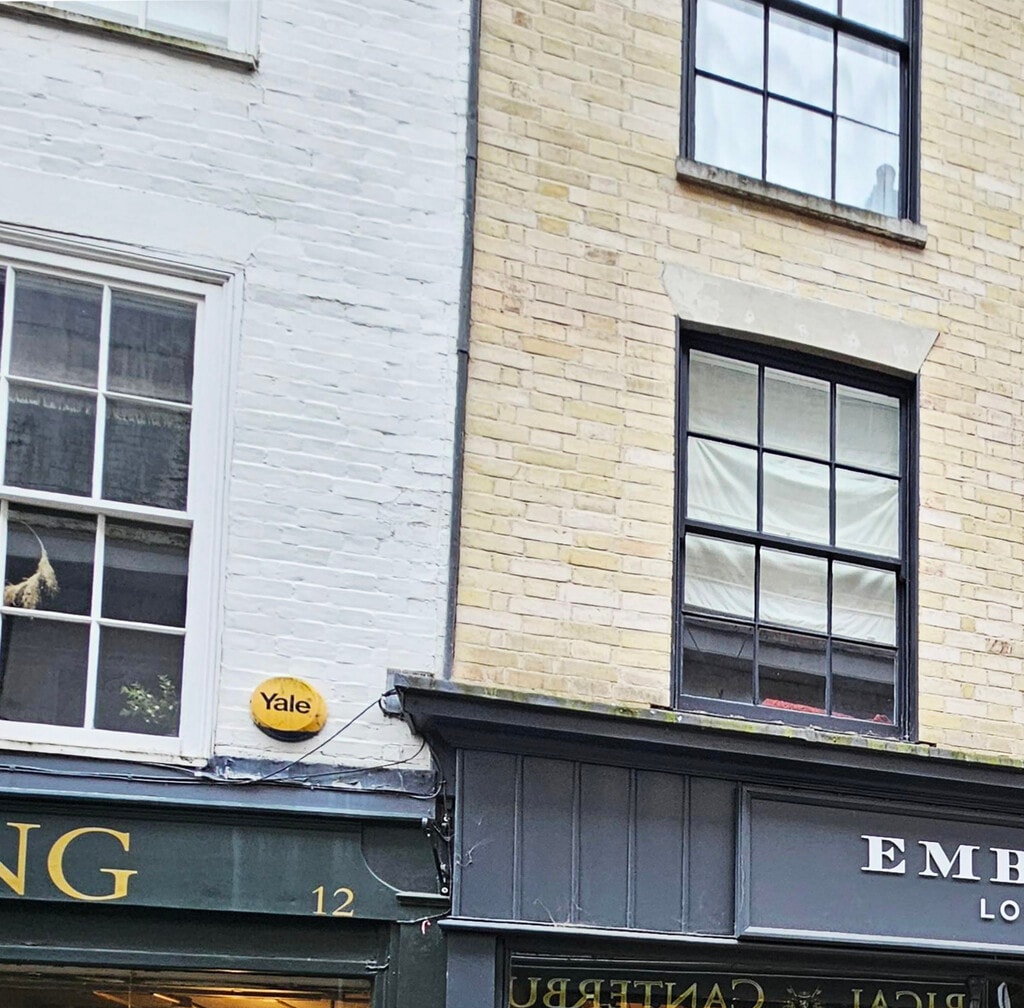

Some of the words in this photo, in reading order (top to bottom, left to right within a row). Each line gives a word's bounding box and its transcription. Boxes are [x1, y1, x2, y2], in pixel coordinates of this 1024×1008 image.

[260, 691, 312, 714] Yale
[0, 821, 138, 901] NG
[311, 885, 355, 918] 12
